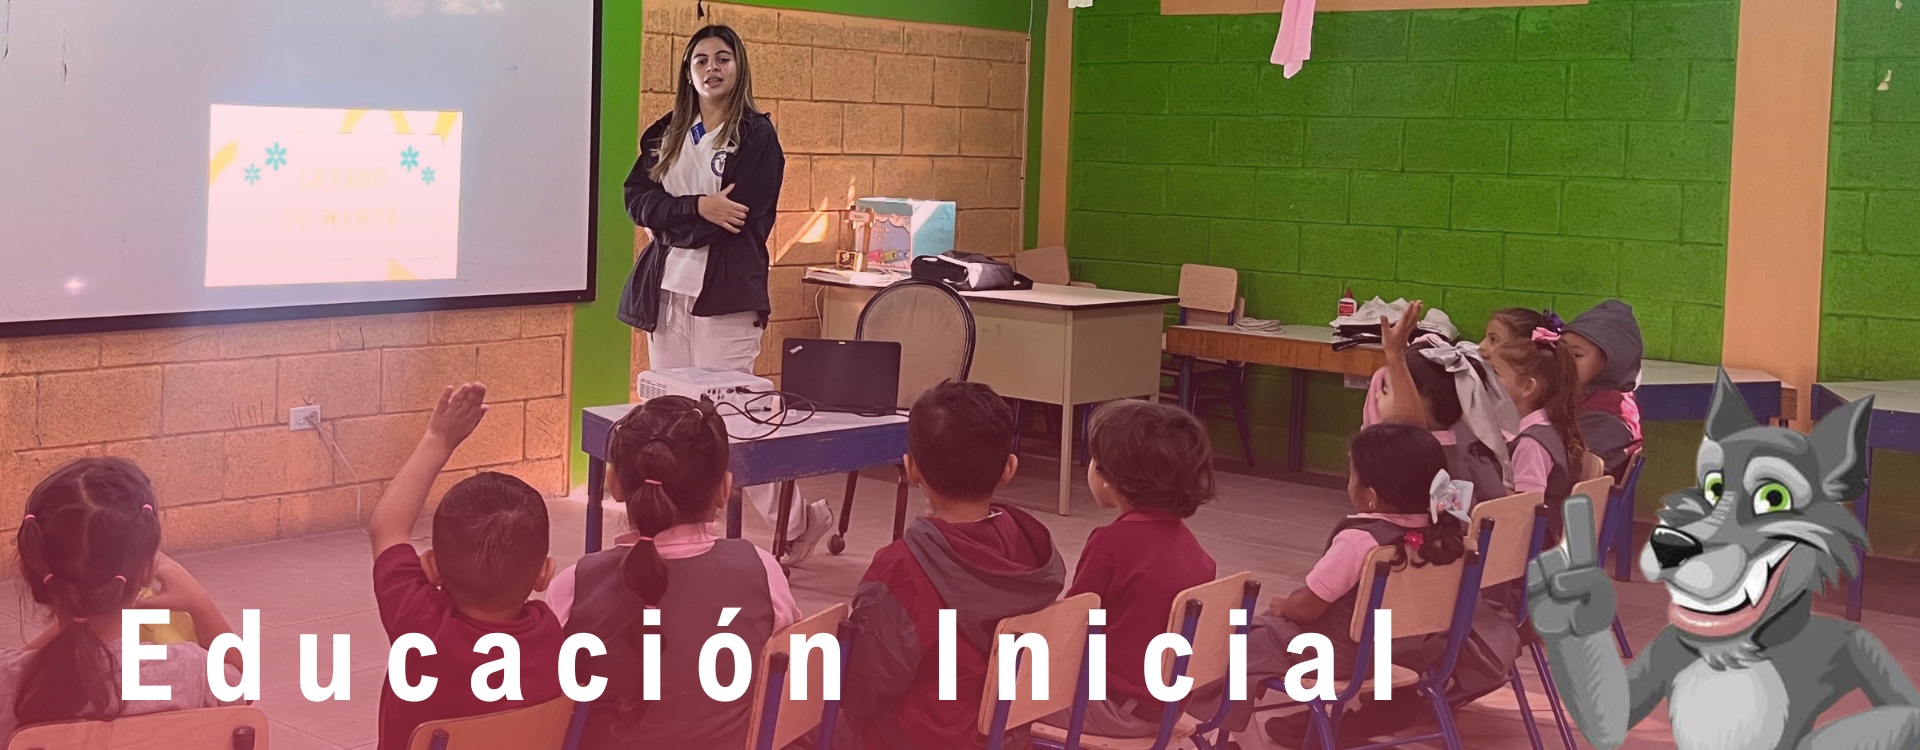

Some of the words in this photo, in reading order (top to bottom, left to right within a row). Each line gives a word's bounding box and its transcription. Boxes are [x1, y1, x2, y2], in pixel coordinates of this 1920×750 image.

[299, 167, 387, 189] LAVADO
[283, 208, 311, 231] DE
[322, 207, 398, 229] MANOS
